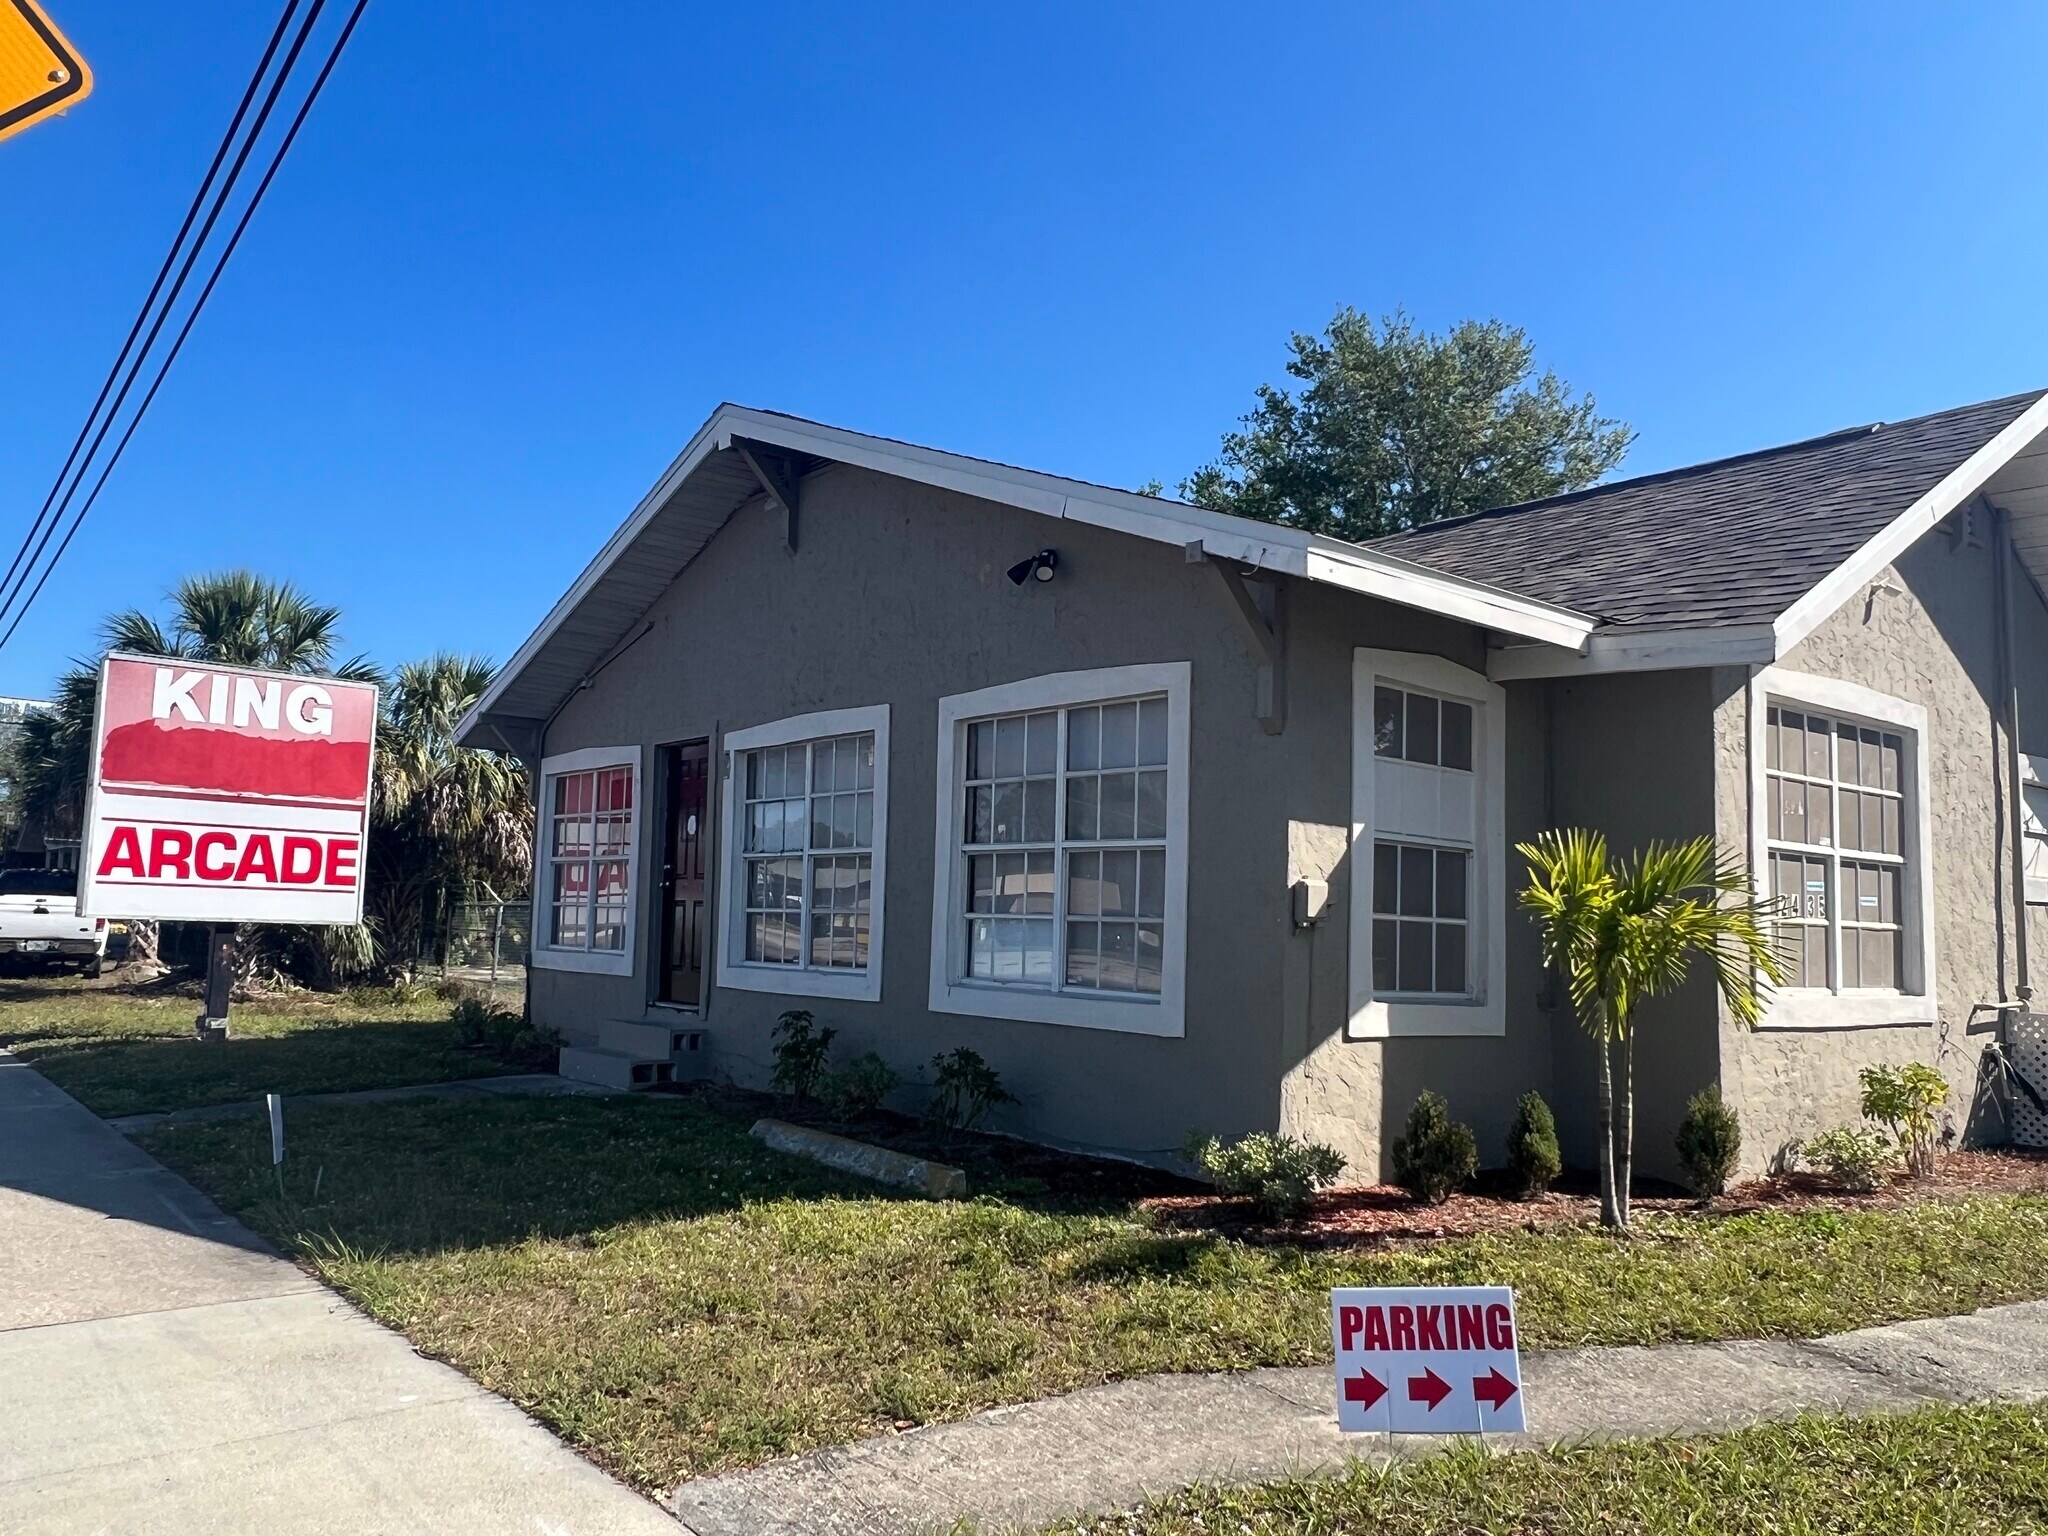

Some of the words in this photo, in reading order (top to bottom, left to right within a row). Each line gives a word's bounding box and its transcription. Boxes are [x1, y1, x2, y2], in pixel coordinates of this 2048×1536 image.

[152, 667, 333, 736] KING
[96, 826, 359, 886] ARCADE
[1339, 1304, 1514, 1351] PARKING
